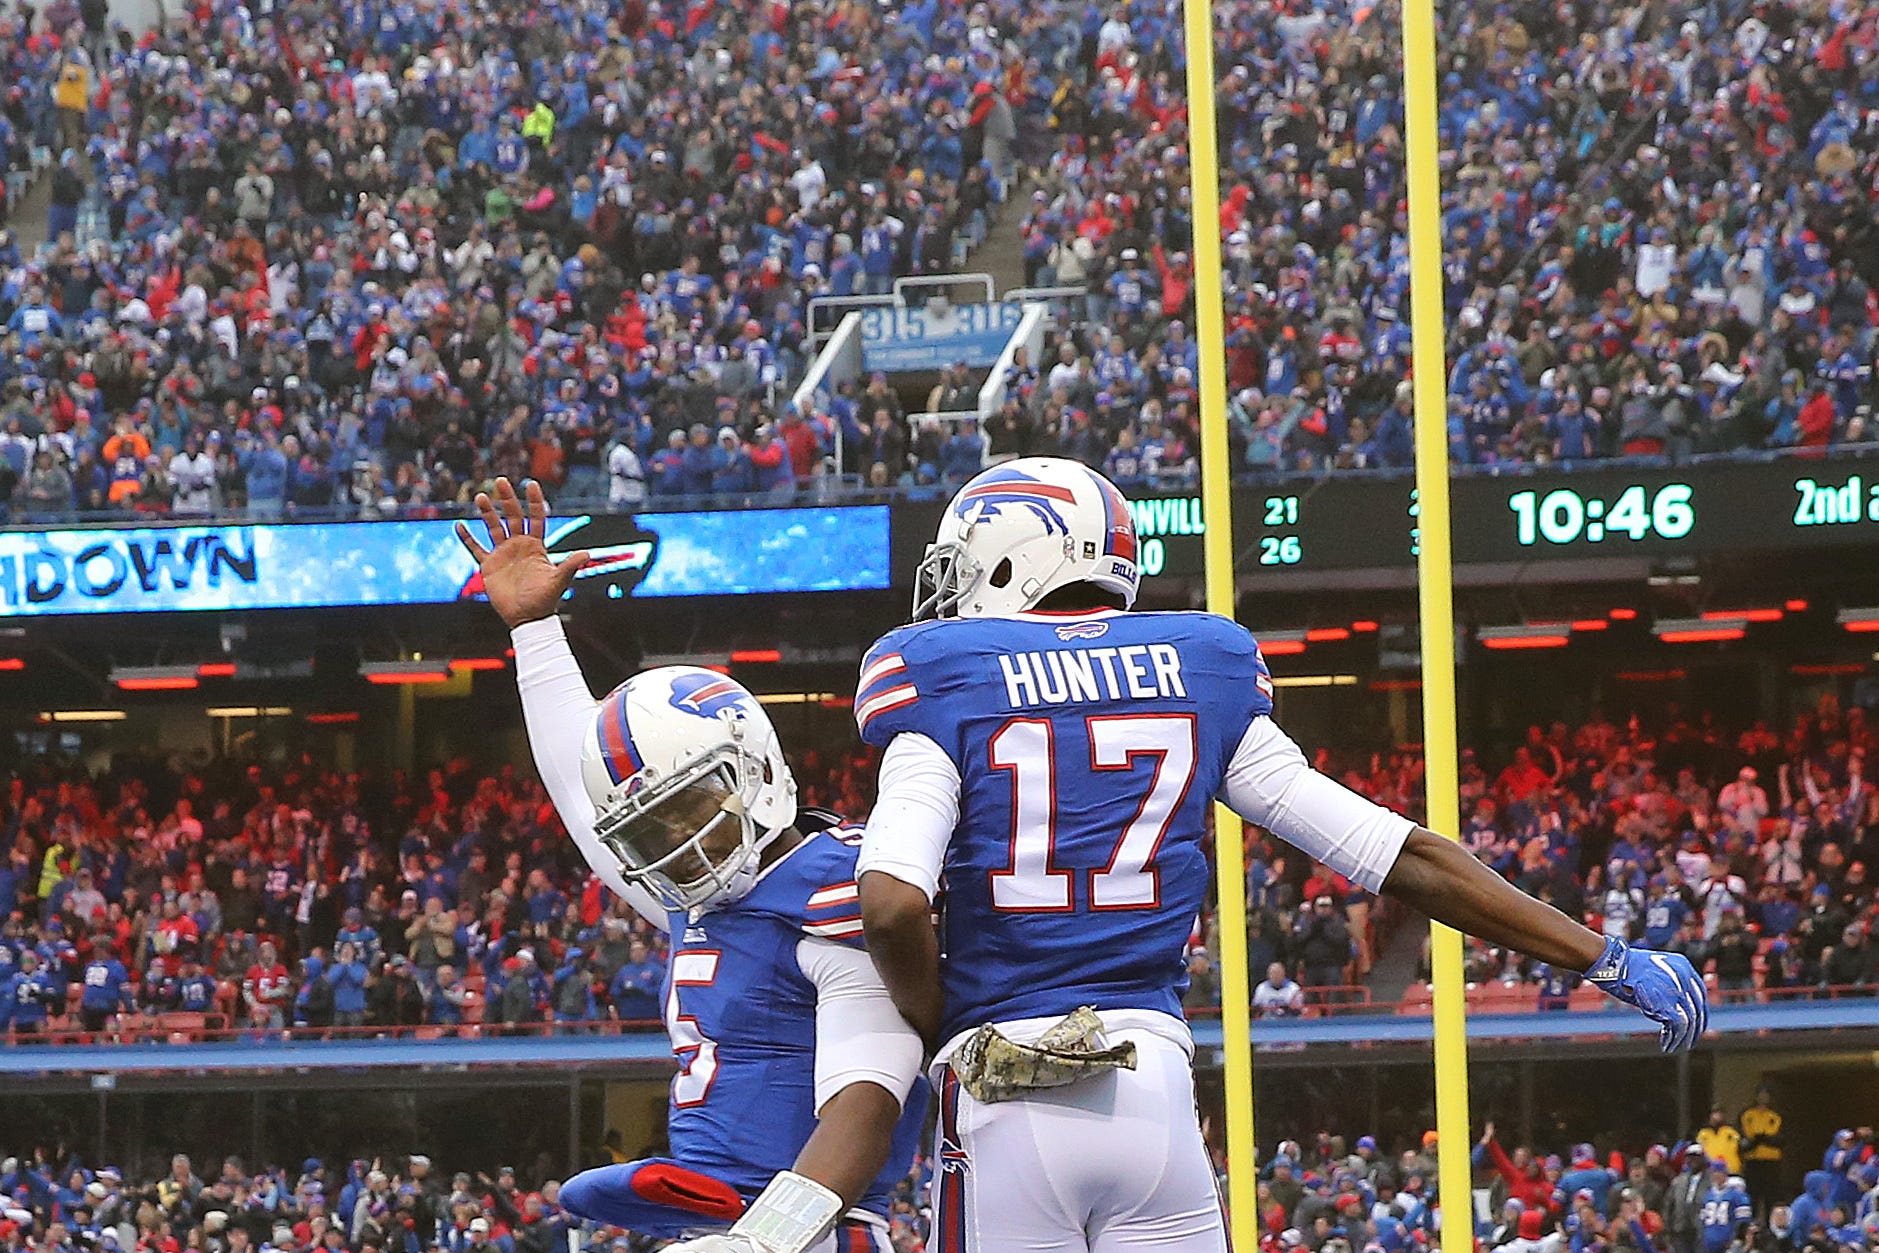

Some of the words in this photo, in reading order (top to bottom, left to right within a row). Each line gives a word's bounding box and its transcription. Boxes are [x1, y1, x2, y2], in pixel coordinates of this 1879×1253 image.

[861, 307, 924, 342] 315
[1129, 498, 1205, 535] NVILL
[1264, 497, 1299, 525] 21
[1509, 484, 1695, 545] 10:46
[1793, 476, 1861, 525] 2nd
[1260, 536, 1301, 565] 26
[999, 643, 1188, 708] HUNTER
[989, 712, 1198, 913] 17
[664, 949, 721, 1108] 5
